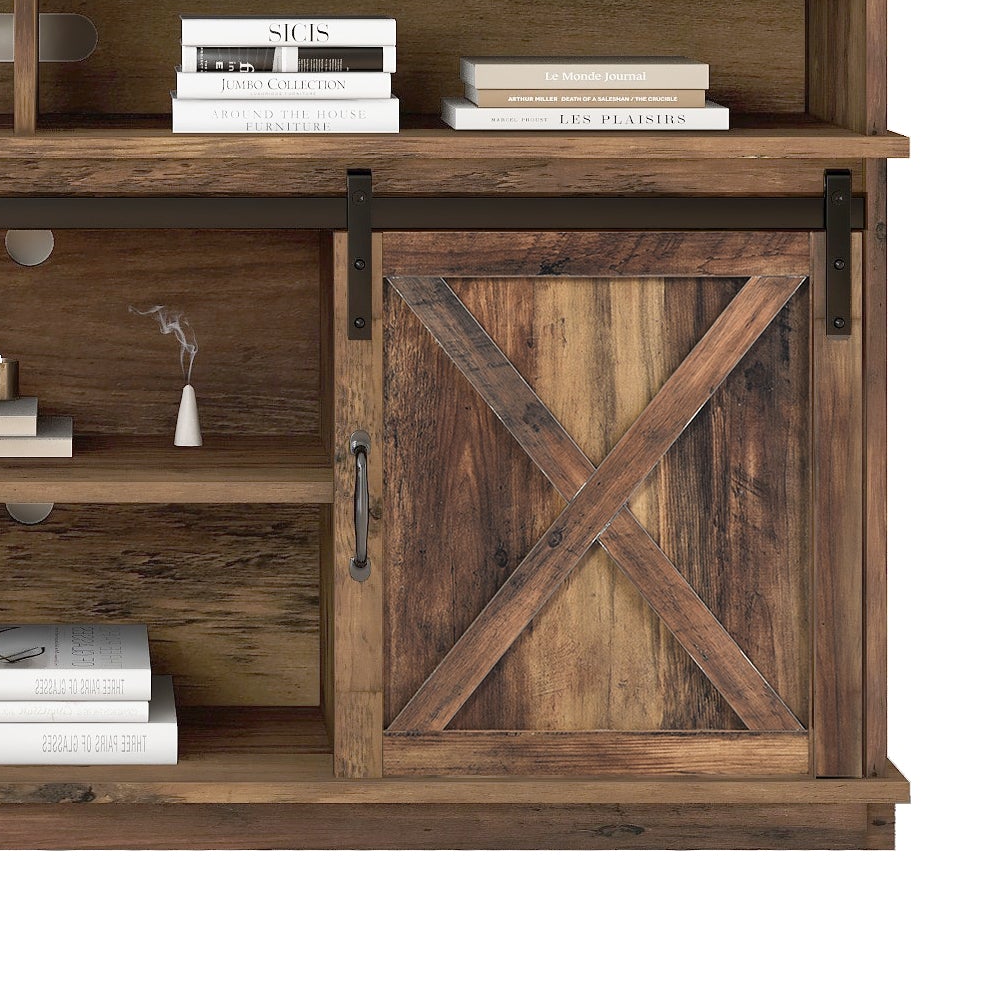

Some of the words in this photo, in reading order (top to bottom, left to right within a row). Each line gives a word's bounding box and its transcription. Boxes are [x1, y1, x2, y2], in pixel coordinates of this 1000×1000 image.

[268, 23, 330, 43] SICIS
[545, 71, 559, 81] Le
[562, 71, 602, 81] Monde
[604, 71, 646, 82] Journal
[211, 110, 274, 119] AROUND
[281, 110, 310, 119] THE
[316, 110, 367, 119] HOUSE
[560, 114, 591, 124] LES
[601, 114, 687, 124] PLAISIRS
[246, 122, 332, 132] FURNITURE
